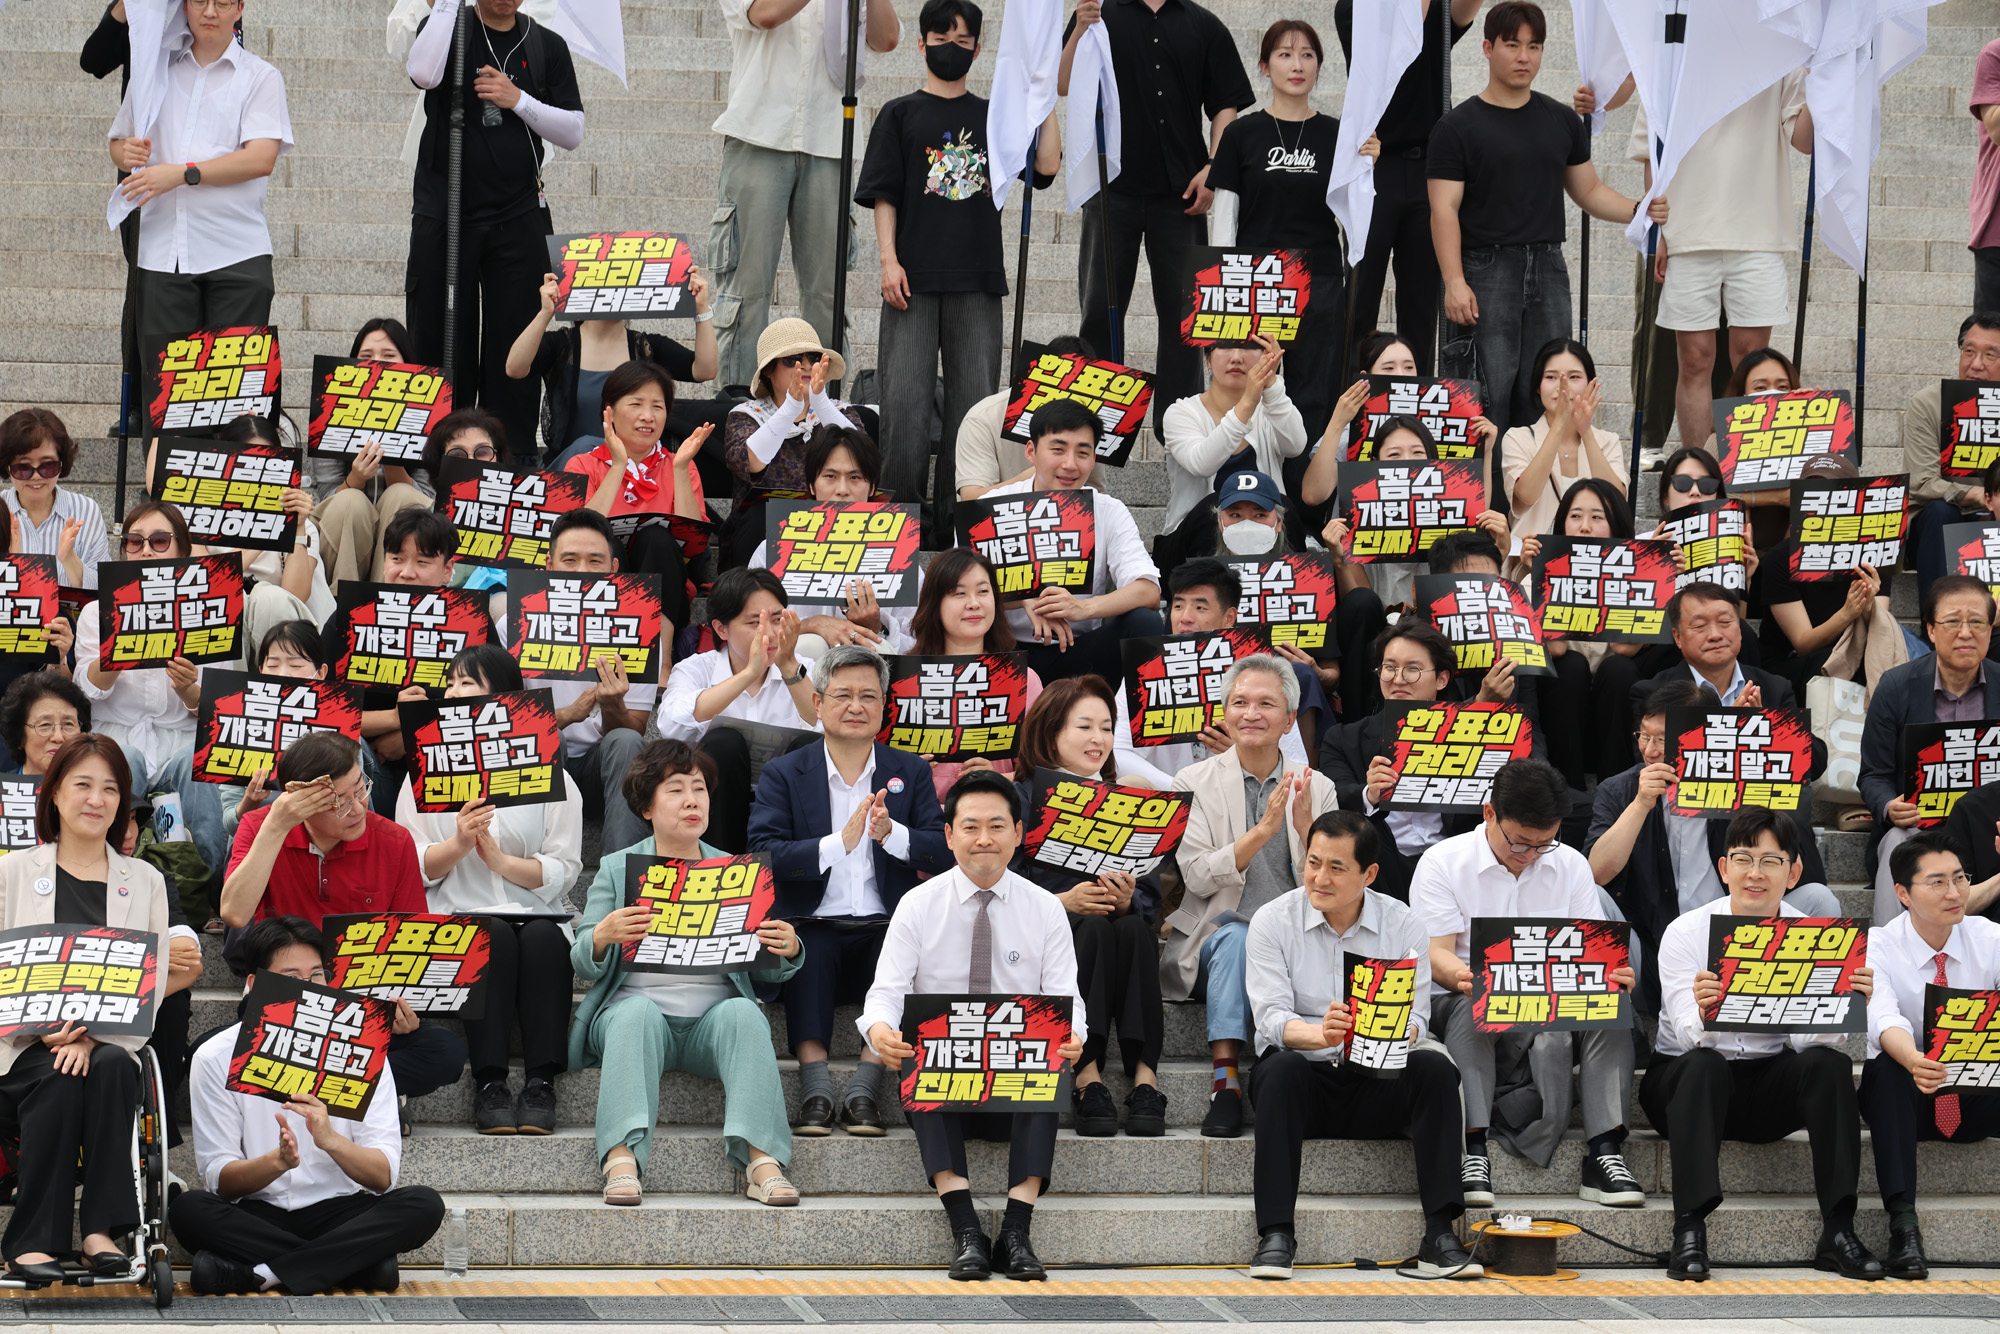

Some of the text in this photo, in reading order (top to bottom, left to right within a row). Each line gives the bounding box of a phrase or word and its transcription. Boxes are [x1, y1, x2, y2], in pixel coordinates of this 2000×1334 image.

[564, 238, 678, 261] 한 표의
[572, 260, 671, 287] 권리를
[1221, 254, 1282, 286] 꼼수
[564, 287, 682, 313] 돌려달라
[1200, 287, 1298, 314] 개헌 말고
[1191, 314, 1253, 340] 진짜
[164, 334, 272, 371] 한 표의
[170, 369, 268, 399] 권리를
[325, 364, 444, 405] 한 표의
[1028, 354, 1147, 406] 한 표의
[330, 396, 432, 434] 권리를
[1389, 383, 1450, 415] 꼼수
[1729, 398, 1840, 432] 한 표의
[1738, 428, 1833, 460] 권리를
[165, 449, 295, 484] 국민 검열
[1238, 475, 1258, 490] D
[478, 469, 546, 508] 꼼수
[1378, 467, 1445, 500] 꼼수
[453, 499, 507, 531] 개헌
[1358, 500, 1467, 527] 개헌 말고
[1800, 486, 1905, 515] 국민 검열
[178, 506, 286, 541] 회하라
[781, 511, 907, 541] 한 표의
[992, 499, 1061, 536] 꼼수
[1800, 512, 1903, 542] 입틀막법
[786, 543, 895, 572] 권리를
[976, 532, 1081, 564] 개헌 말고
[1353, 530, 1413, 554] 진짜
[1800, 540, 1900, 571] 철회하라
[1038, 561, 1088, 587] 특검
[1570, 544, 1636, 578] 꼼수
[141, 565, 209, 601] 꼼수
[548, 579, 618, 615] 꼼수
[1455, 580, 1513, 612] 꼼수
[1550, 577, 1658, 607] 개헌 말고
[119, 598, 228, 630] 개헌 말고
[377, 591, 446, 628] 꼼수
[1266, 595, 1317, 623] 말고
[1541, 605, 1666, 635] 진짜 특검
[355, 625, 466, 659] 개헌 말고
[526, 614, 642, 644] 개헌 말고
[1271, 623, 1327, 649] 특검
[1437, 614, 1536, 640] 개헌 말고
[112, 626, 236, 662] 진짜 특검
[519, 643, 649, 674] 진짜 특검
[1163, 640, 1234, 676] 꼼수
[347, 655, 451, 688] 진짜 특
[920, 662, 989, 697] 꼼수
[244, 681, 318, 722] 꼼수
[1145, 677, 1201, 706] 개헌
[438, 702, 511, 742] 꼼수
[896, 698, 1009, 725] 개헌 말고
[1144, 707, 1204, 737] 진짜
[1398, 708, 1522, 744] 한 표의
[218, 716, 274, 748] 개헌
[889, 724, 1017, 754] 진짜 특검
[1705, 714, 1772, 750] 꼼수
[205, 747, 273, 778] 진짜
[423, 736, 539, 772] 개헌 말고
[1403, 743, 1511, 777] 권리를
[1684, 751, 1793, 780] 개헌 말고
[424, 765, 552, 803] 진짜 특검
[1391, 776, 1494, 805] 돌려달
[1923, 762, 1973, 789] 개헌
[1047, 781, 1182, 828] 한 표의
[1678, 782, 1802, 810] 진짜 특검
[1051, 812, 1161, 855] 권리를
[640, 863, 760, 901] 한 표의
[644, 901, 749, 936] 권리를
[70, 937, 147, 967] 검열
[337, 921, 478, 956] 한 표의
[633, 934, 761, 966] 돌려달라
[1512, 926, 1584, 962] 꼼수
[1724, 925, 1859, 960] 한 표의
[342, 955, 461, 988] 권리를
[1352, 964, 1374, 1000] 한
[1490, 964, 1606, 991] 개헌 말고
[1729, 962, 1838, 995] 권리를
[294, 990, 367, 1040] 꼼수
[949, 1002, 1025, 1038] 꼼수
[1487, 994, 1619, 1022] 진짜 특검
[1716, 997, 1851, 1025] 돌려달라
[1936, 997, 1986, 1029] 한
[260, 1023, 372, 1077] 개헌 말고
[923, 1039, 1048, 1069] 개헌 말고
[239, 1056, 370, 1109] 진짜 특검
[915, 1072, 1060, 1101] 진짜 특검
